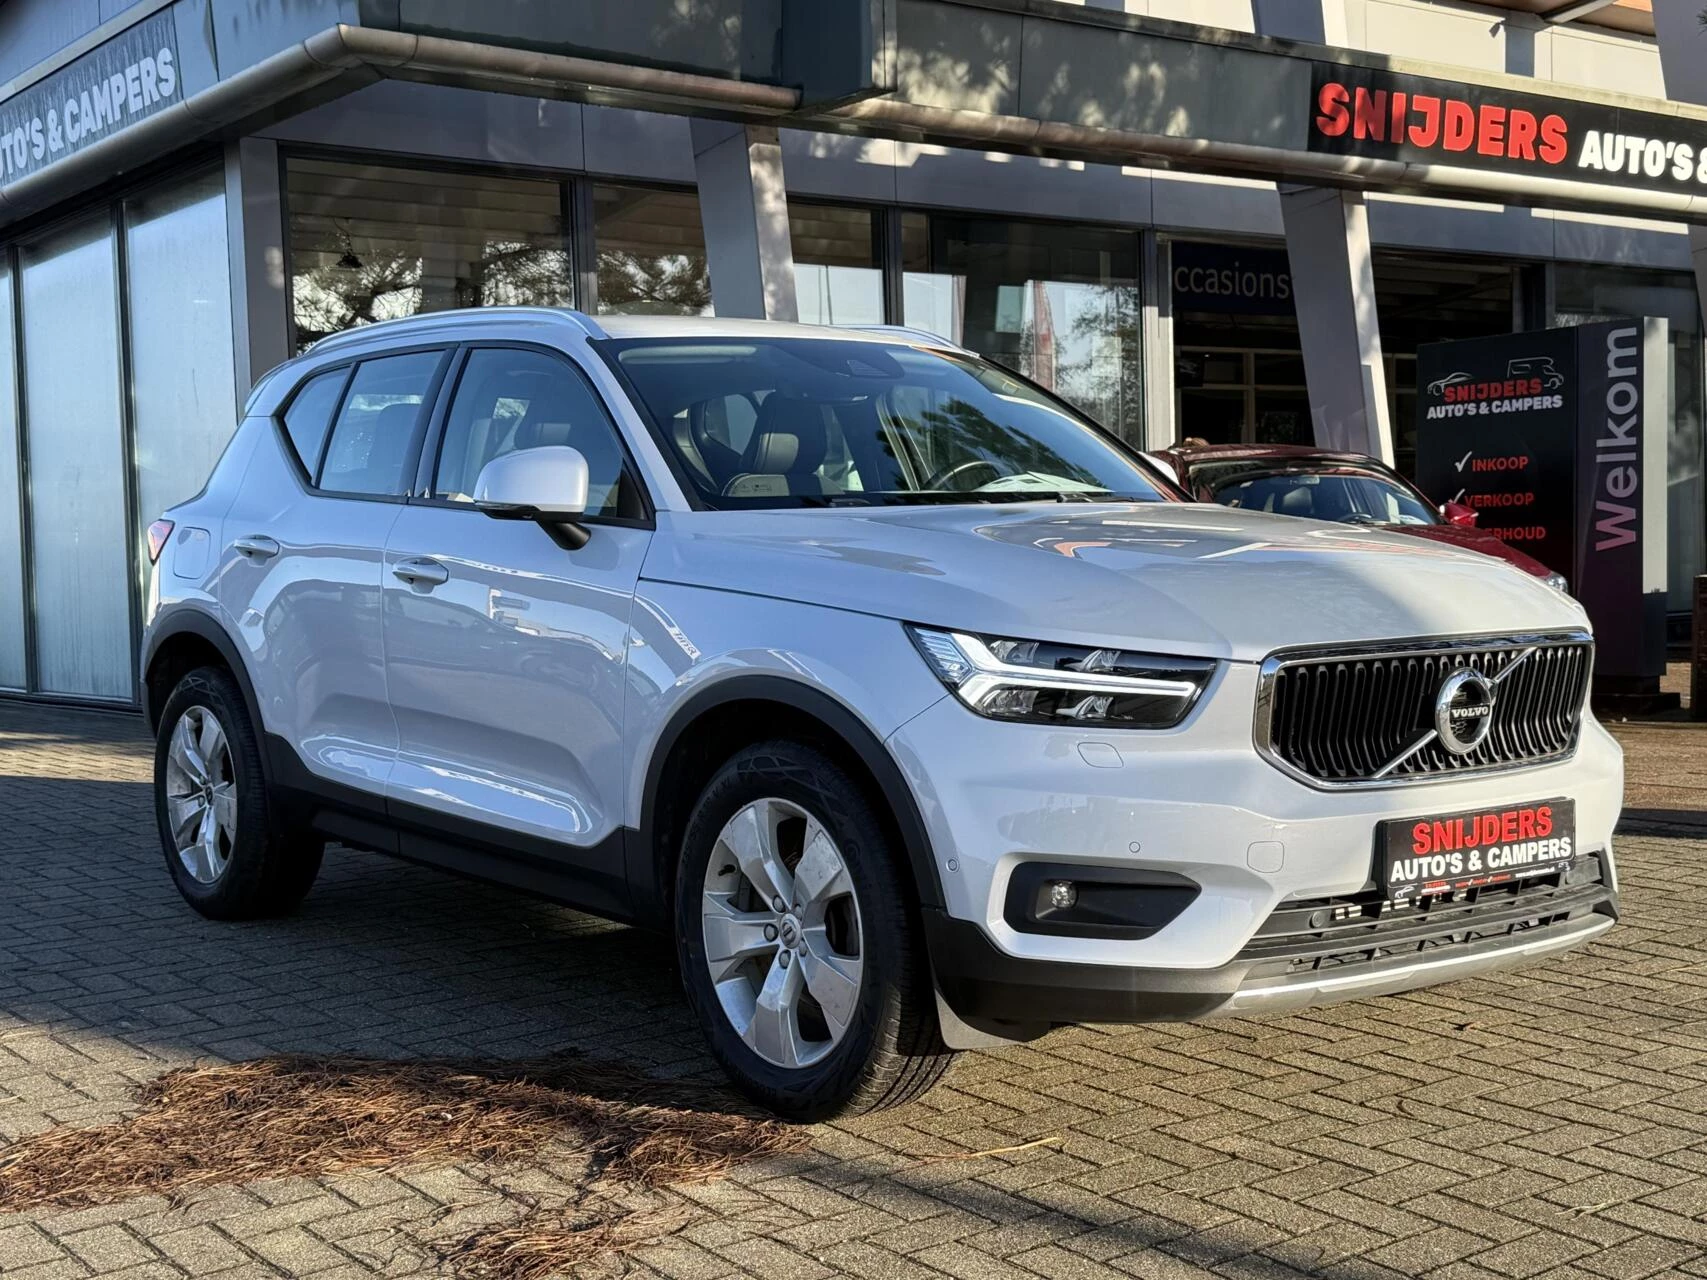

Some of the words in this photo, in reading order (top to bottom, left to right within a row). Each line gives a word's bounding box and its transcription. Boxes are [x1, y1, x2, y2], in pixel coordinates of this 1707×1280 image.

[0, 117, 45, 178] TO'S
[47, 109, 64, 152] &
[64, 48, 175, 143] CAMPERS
[1316, 82, 1568, 164] SNIJDERS
[1578, 130, 1693, 181] AUTO'S
[1426, 403, 1477, 419] AUTO'S
[1479, 402, 1489, 414] &
[1491, 395, 1563, 413] CAMPERS
[1443, 378, 1543, 402] SNIJDERS
[1596, 327, 1638, 551] Welkom
[1472, 456, 1528, 471] INKOOP
[1464, 492, 1534, 508] VERKOOP
[1451, 706, 1488, 718] VOLVO
[1412, 806, 1553, 855] SNIJDERS
[1390, 852, 1463, 883] AUTO'S
[1468, 850, 1483, 871] &
[1487, 837, 1571, 869] CAMPERS
